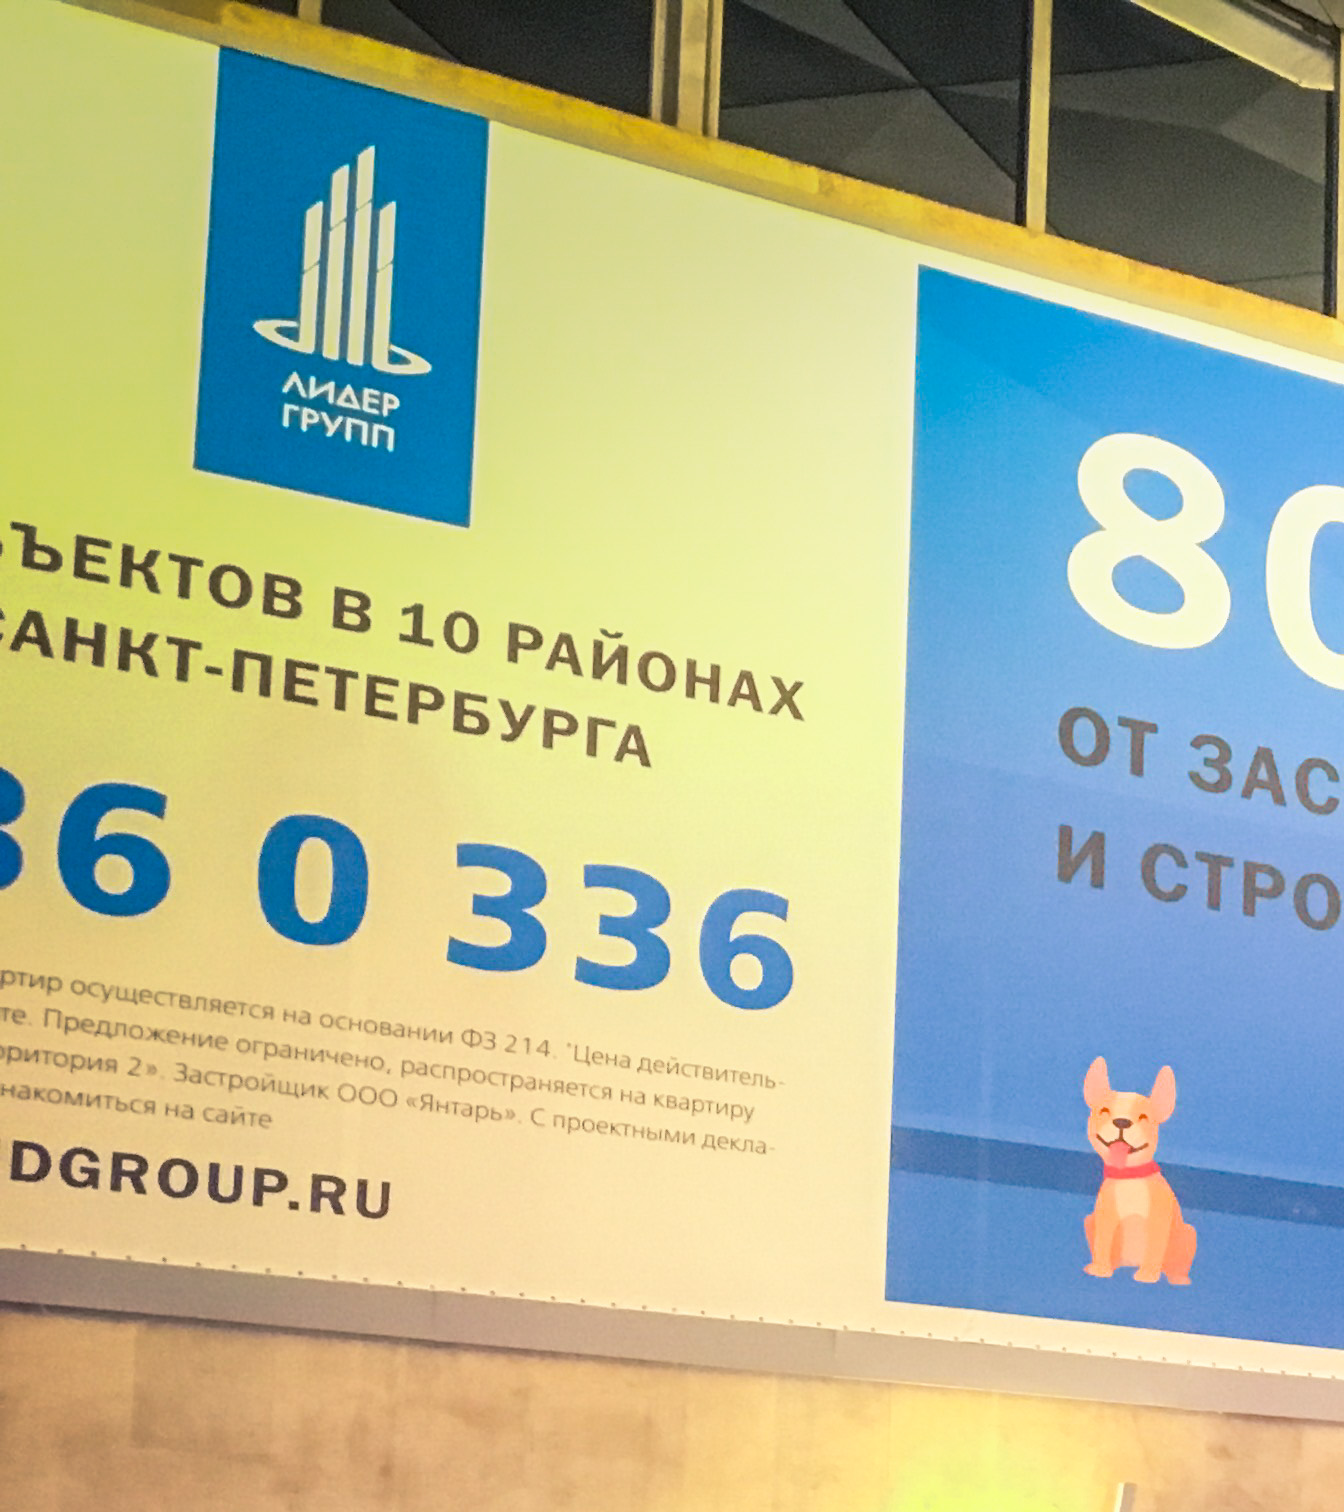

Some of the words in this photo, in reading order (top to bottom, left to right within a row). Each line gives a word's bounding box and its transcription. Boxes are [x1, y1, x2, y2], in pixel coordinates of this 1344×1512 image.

[282, 371, 400, 417] ЛИДЕР
[282, 403, 395, 452] ГРУПП
[0, 522, 303, 619] ЪЕКТОВ
[332, 586, 371, 633] В
[399, 602, 479, 654] 10
[507, 621, 805, 721] РАЙОНАХ
[0, 608, 652, 768] АНКТ-ПЕТЕРБУРГА
[1058, 706, 1158, 777] ОТ
[0, 766, 171, 917] 6
[258, 814, 369, 946] 0
[446, 843, 795, 1011] 336
[1057, 825, 1106, 889] И
[43, 1007, 229, 1050] Предложение
[235, 1037, 391, 1076] ограничено,
[401, 1058, 612, 1101] распространяется
[620, 1089, 646, 1106] на
[653, 1092, 755, 1124] квартиру
[70, 978, 275, 1021] осуществляется
[283, 1008, 312, 1026] на
[319, 1013, 453, 1045] основании
[636, 1055, 786, 1091] действитель-
[164, 1099, 195, 1122] на
[202, 1104, 273, 1130] сайте
[174, 1062, 329, 1101] Застройщик
[337, 1082, 398, 1108] ООО
[530, 1107, 546, 1128] С
[552, 1112, 696, 1148] проектными
